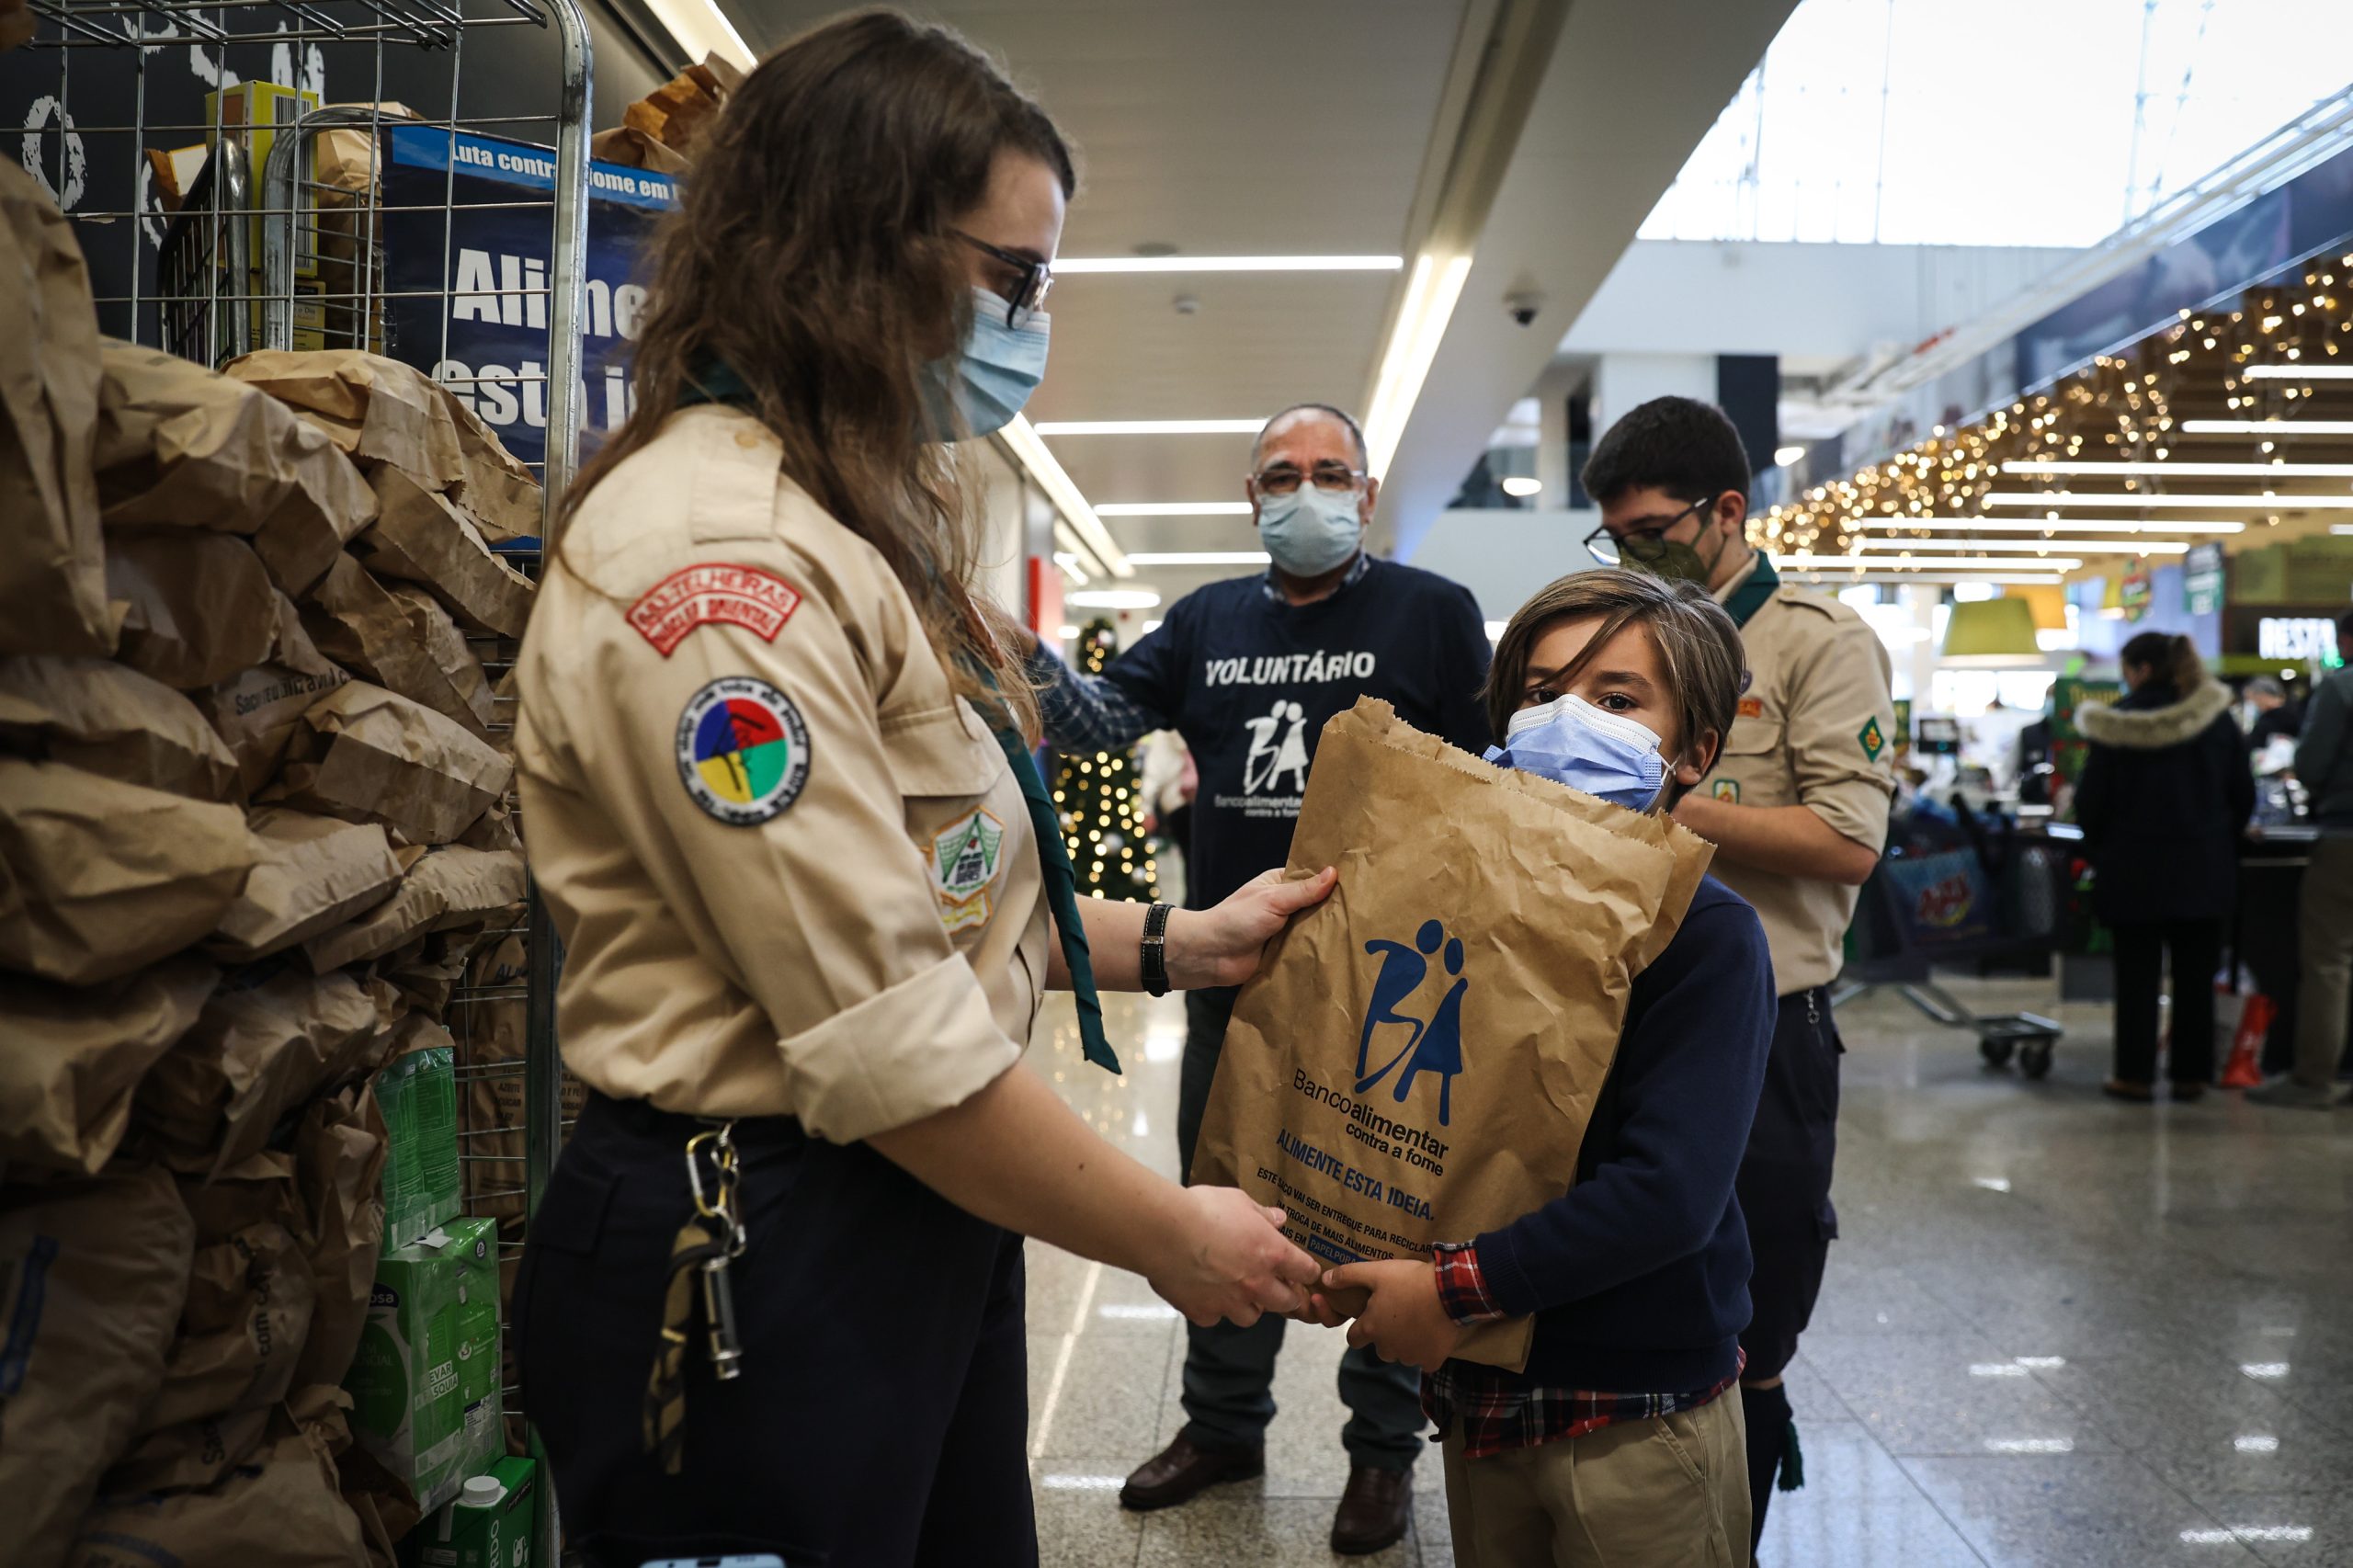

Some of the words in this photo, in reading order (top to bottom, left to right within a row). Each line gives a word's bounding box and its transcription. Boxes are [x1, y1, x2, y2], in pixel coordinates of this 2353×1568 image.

[638, 179, 670, 200] em
[431, 359, 589, 431] est
[1205, 649, 1376, 687] VOLUNTÁRIO
[1213, 794, 1302, 808] Bancoalimenta
[1293, 1068, 1449, 1160] Bancoalimentar
[1276, 1129, 1345, 1181] ALIMENTE
[1344, 1167, 1382, 1202] ESTA
[1387, 1187, 1435, 1221] IDEIA.
[1346, 1123, 1388, 1154] contra
[1392, 1148, 1402, 1159] a
[1405, 1148, 1444, 1176] fome
[1256, 1167, 1279, 1185] ESTE
[1293, 1188, 1306, 1204] VAI
[1305, 1197, 1321, 1212] SER
[1321, 1206, 1363, 1233] ENTREGUE
[1364, 1224, 1388, 1243] PARA
[1389, 1233, 1432, 1254] RECICLAR
[1279, 1225, 1293, 1241] AIS
[1294, 1232, 1307, 1246] EM
[1286, 1206, 1310, 1228] TROCA
[1311, 1221, 1322, 1233] DE
[1323, 1226, 1345, 1244] MAIS
[1344, 1236, 1394, 1261] ALIMENTOS
